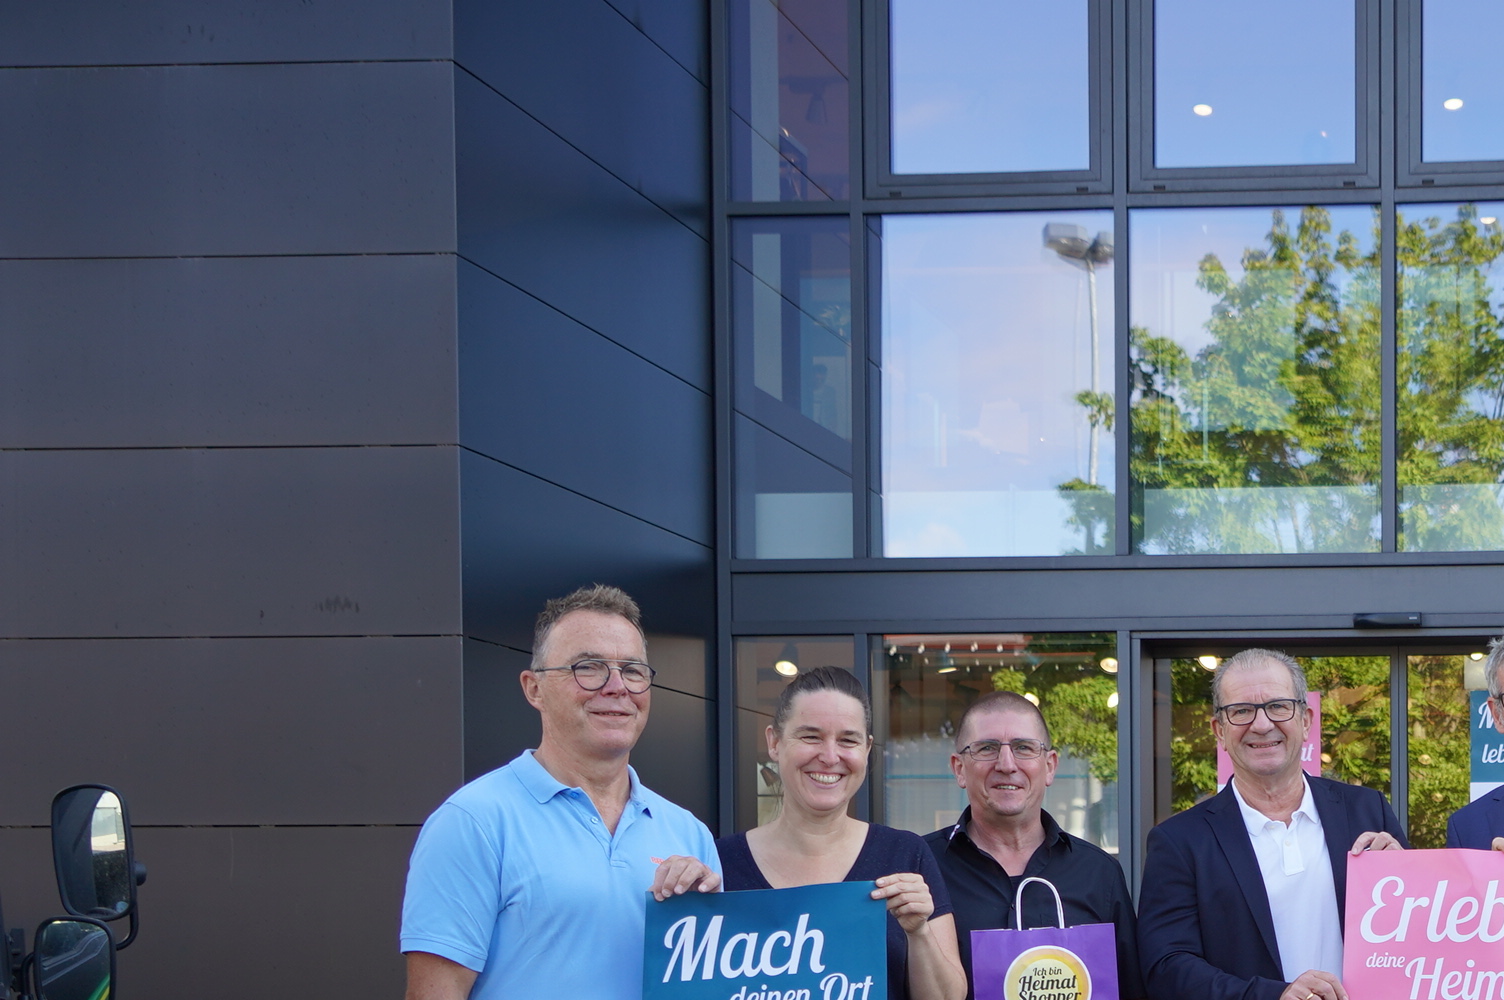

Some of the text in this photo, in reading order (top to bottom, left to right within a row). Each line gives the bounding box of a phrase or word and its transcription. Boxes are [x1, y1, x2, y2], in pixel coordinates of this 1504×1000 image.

[662, 913, 825, 983] Mach
[1365, 952, 1406, 968] deine
[1032, 966, 1062, 976] Ich bin
[1018, 974, 1078, 992] Heimat
